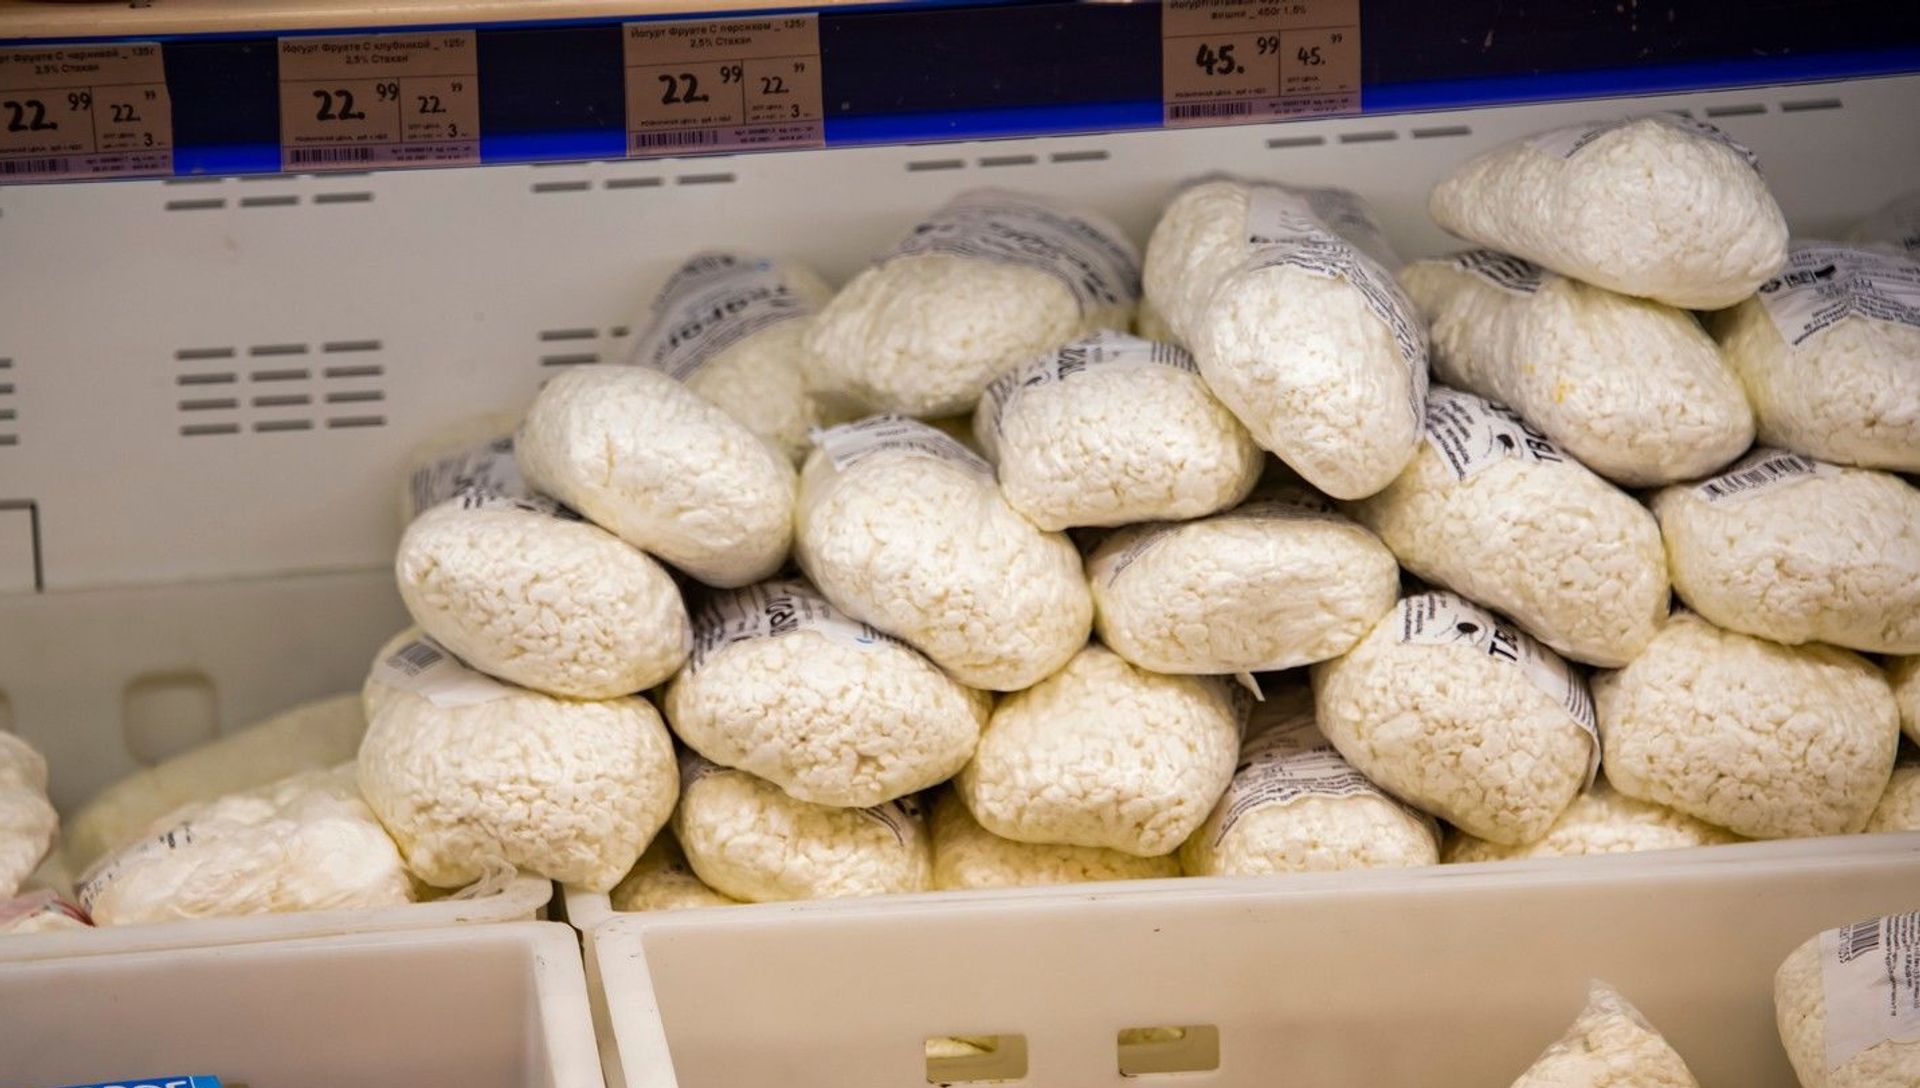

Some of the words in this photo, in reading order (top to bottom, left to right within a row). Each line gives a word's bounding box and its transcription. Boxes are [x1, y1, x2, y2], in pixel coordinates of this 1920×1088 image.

[709, 24, 718, 34] С
[363, 42, 373, 50] С
[374, 40, 430, 52] клубникой
[715, 36, 752, 47] Стакан
[1256, 36, 1279, 55] 99
[371, 54, 408, 64] Стакан
[720, 65, 743, 84] 99
[375, 83, 398, 101] 99
[67, 92, 91, 111] 99
[790, 104, 800, 118] 3
[448, 124, 458, 138] 3
[143, 133, 154, 146] 3
